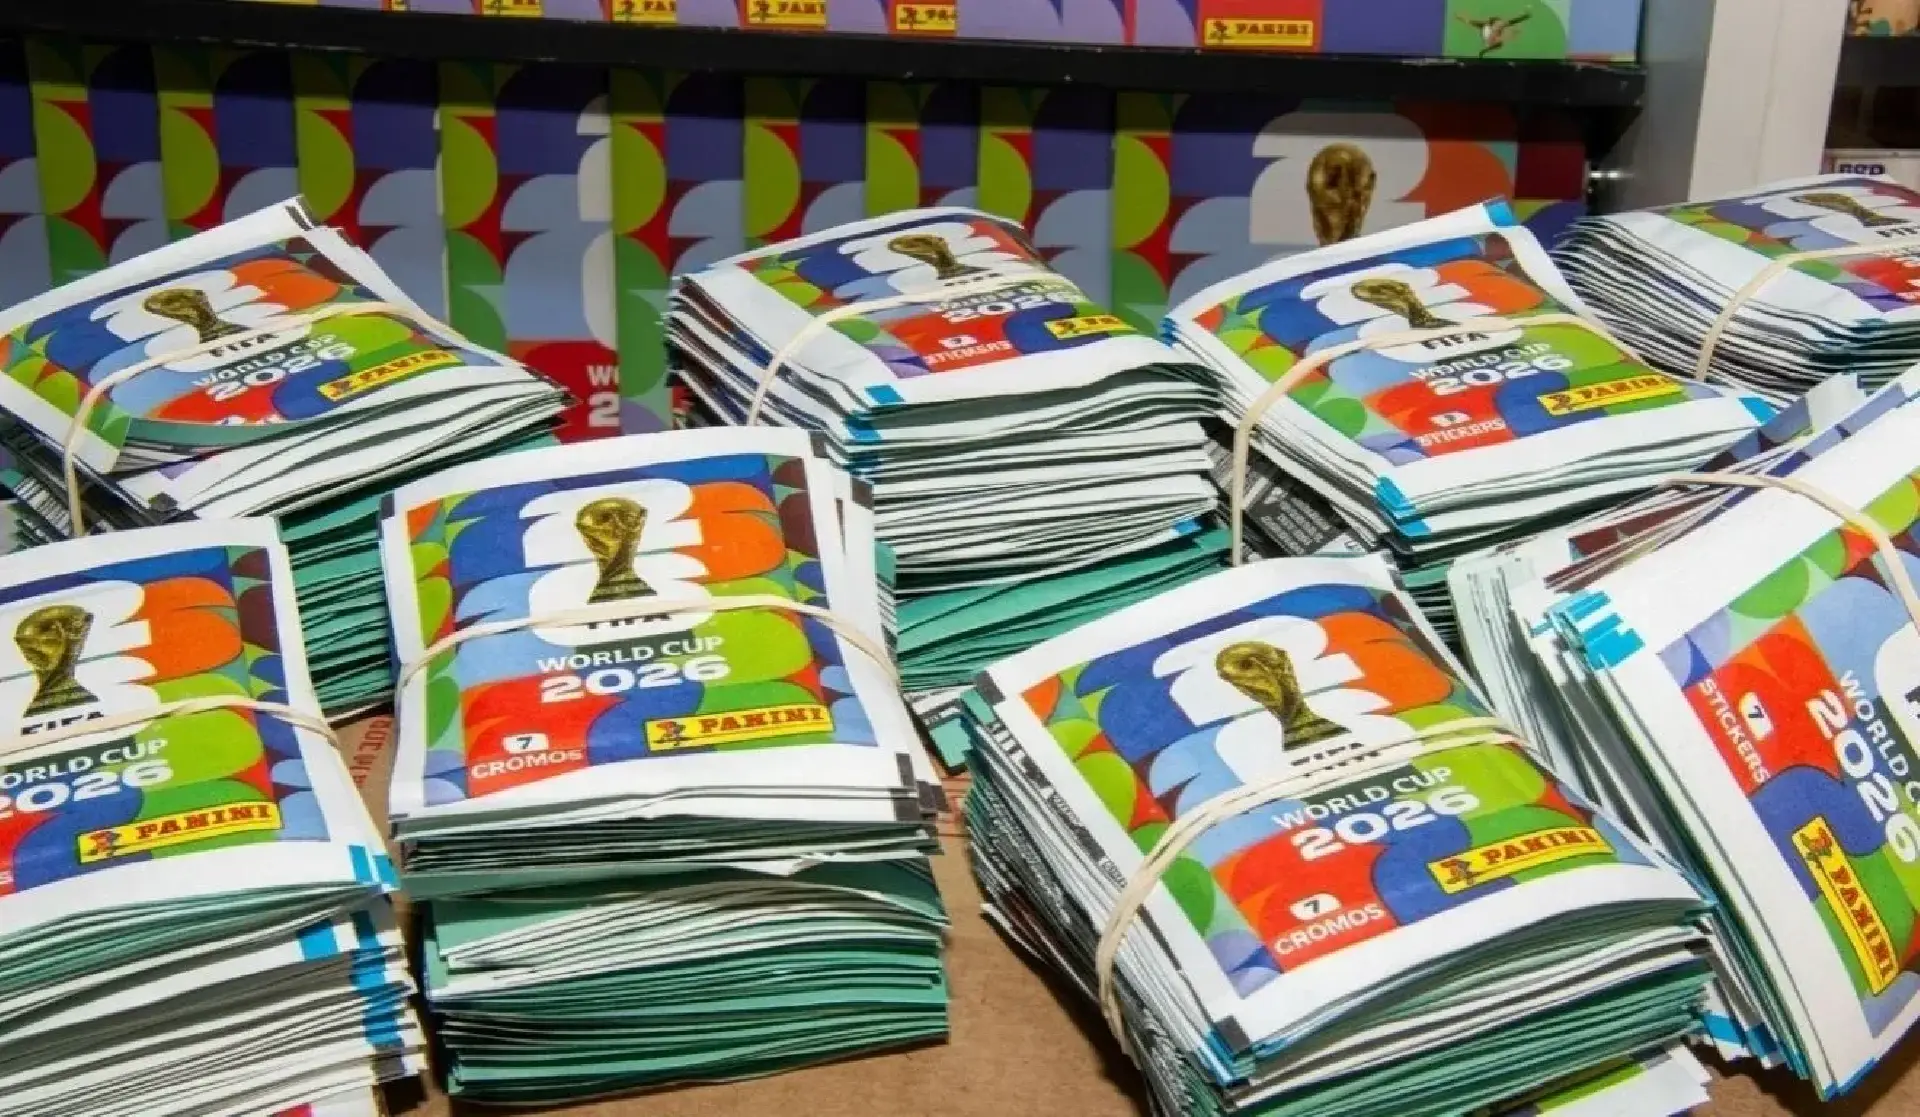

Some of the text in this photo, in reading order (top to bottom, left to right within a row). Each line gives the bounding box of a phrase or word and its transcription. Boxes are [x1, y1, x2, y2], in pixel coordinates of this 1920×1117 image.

[1236, 23, 1309, 35] PANINI
[205, 342, 357, 402] 2026
[1409, 343, 1552, 380] WORLD CUP
[1427, 354, 1573, 396] 2026
[1414, 417, 1507, 447] STICKERS
[536, 636, 725, 673] WORLD CUP
[539, 654, 731, 704] 2026
[516, 736, 534, 749] 7
[699, 706, 825, 734] PANINI
[1699, 677, 1771, 784] STICKERS
[1840, 669, 1910, 776] WORLD
[0, 739, 168, 790] ORLD CUP
[471, 749, 584, 779] CROMOS
[1804, 688, 1918, 864] 2026
[1271, 766, 1452, 830] WORLD CUP
[136, 804, 271, 840] PANINI
[1290, 785, 1480, 862] 2026
[1482, 829, 1599, 866] PANINI
[1273, 902, 1386, 956] CROMOS
[1828, 865, 1894, 979] PANINI
